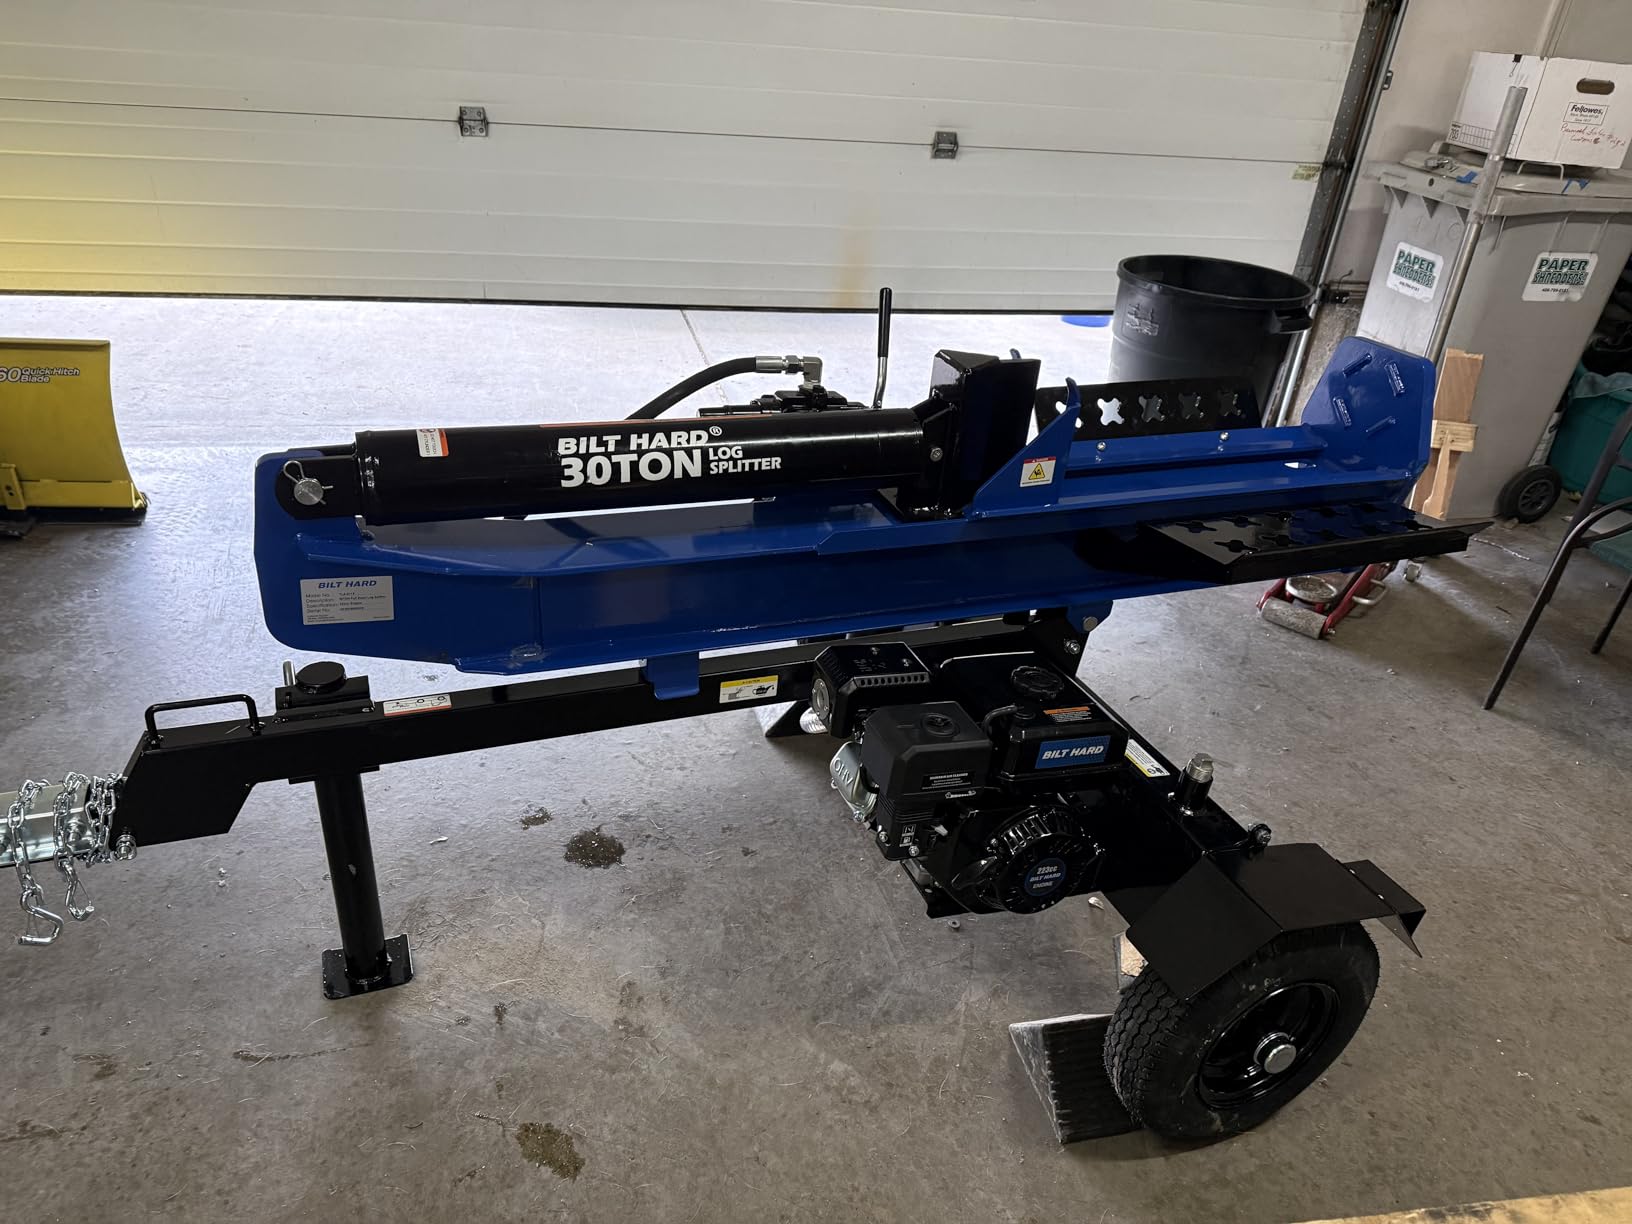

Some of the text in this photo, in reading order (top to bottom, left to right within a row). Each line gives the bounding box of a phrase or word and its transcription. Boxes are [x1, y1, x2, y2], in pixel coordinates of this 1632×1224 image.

[1397, 248, 1436, 273] PAPER
[1538, 257, 1589, 271] PAPER
[20, 375, 50, 383] Blade
[557, 434, 622, 455] BILT
[708, 446, 744, 461] LOG
[560, 449, 703, 488] 30TON
[709, 456, 782, 475] SPLITTER
[318, 580, 377, 589] BILT HARD
[1041, 745, 1104, 760] BILT HARD
[834, 757, 854, 786] OHV
[1043, 872, 1062, 880] HARD
